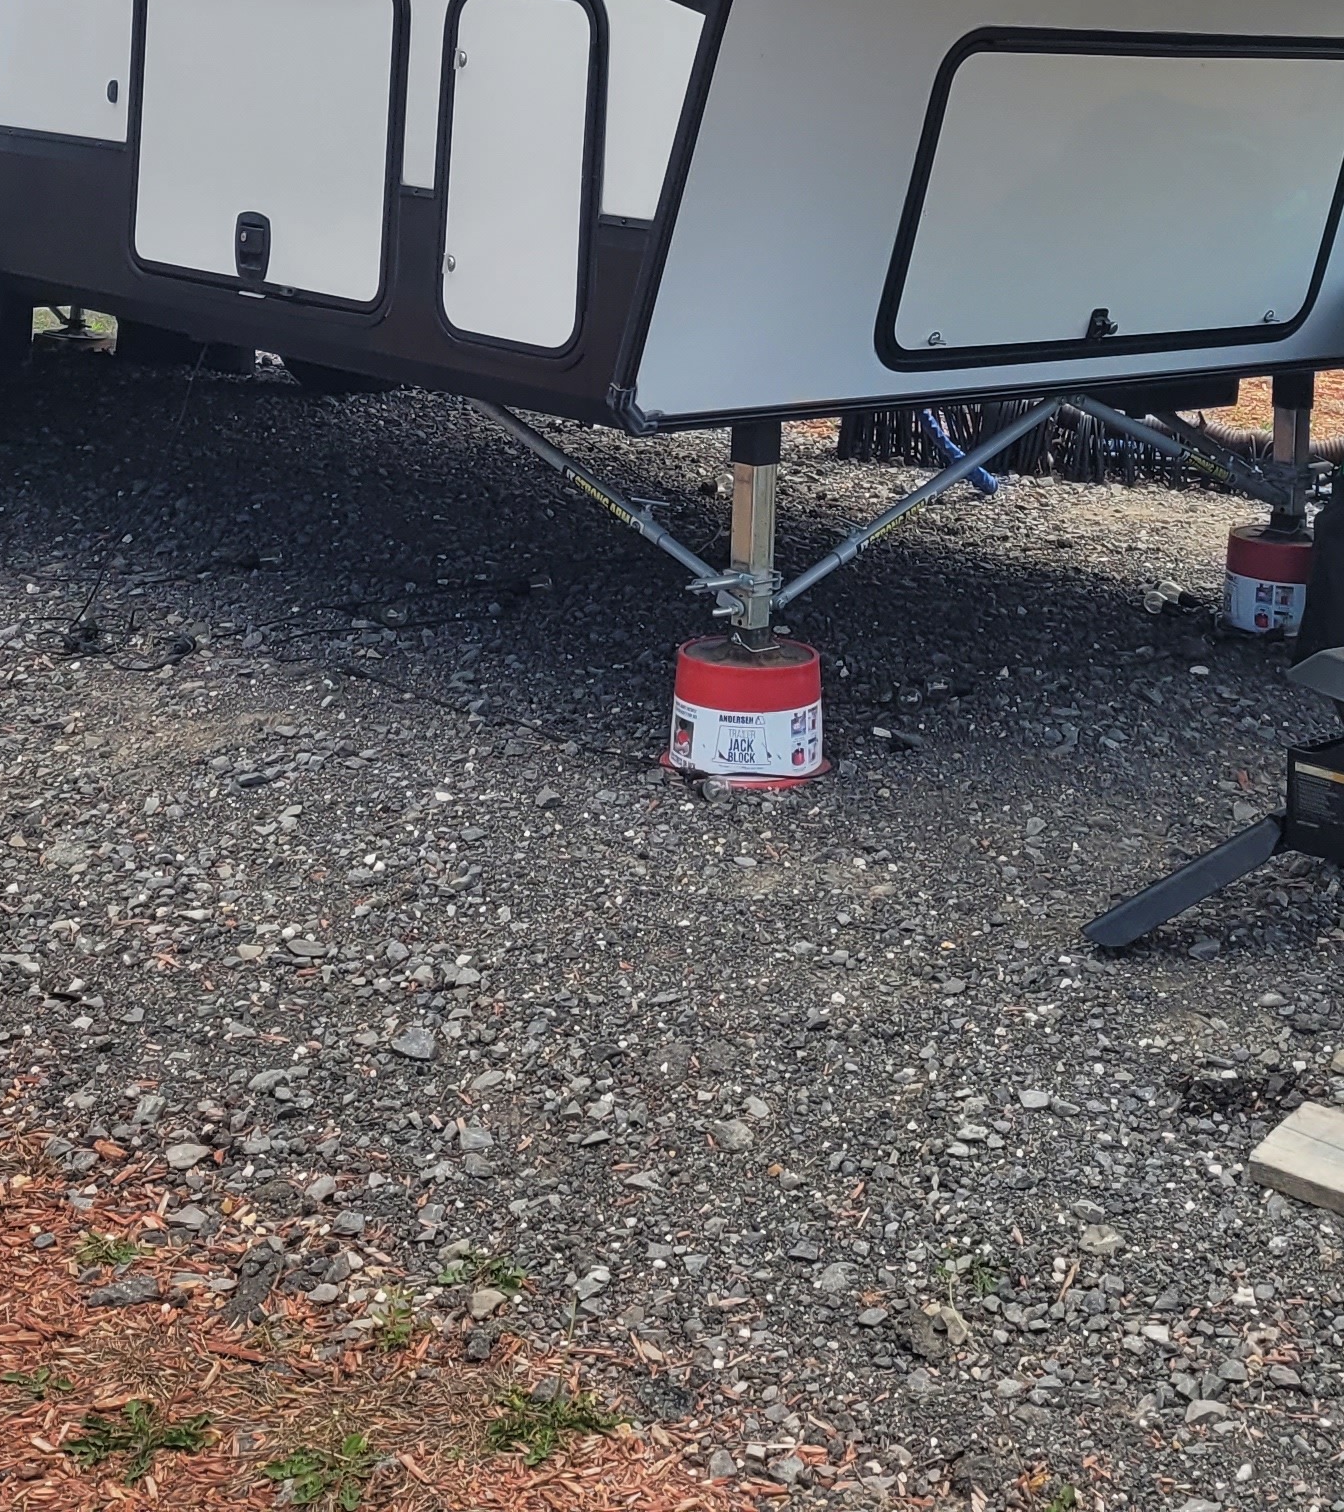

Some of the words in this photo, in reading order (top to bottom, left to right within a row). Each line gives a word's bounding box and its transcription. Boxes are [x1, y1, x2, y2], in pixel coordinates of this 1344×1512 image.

[719, 714, 754, 725] ANDERSEN
[728, 728, 755, 738] TRAILER
[728, 738, 755, 752] JACK
[727, 752, 755, 764] BLOCK
